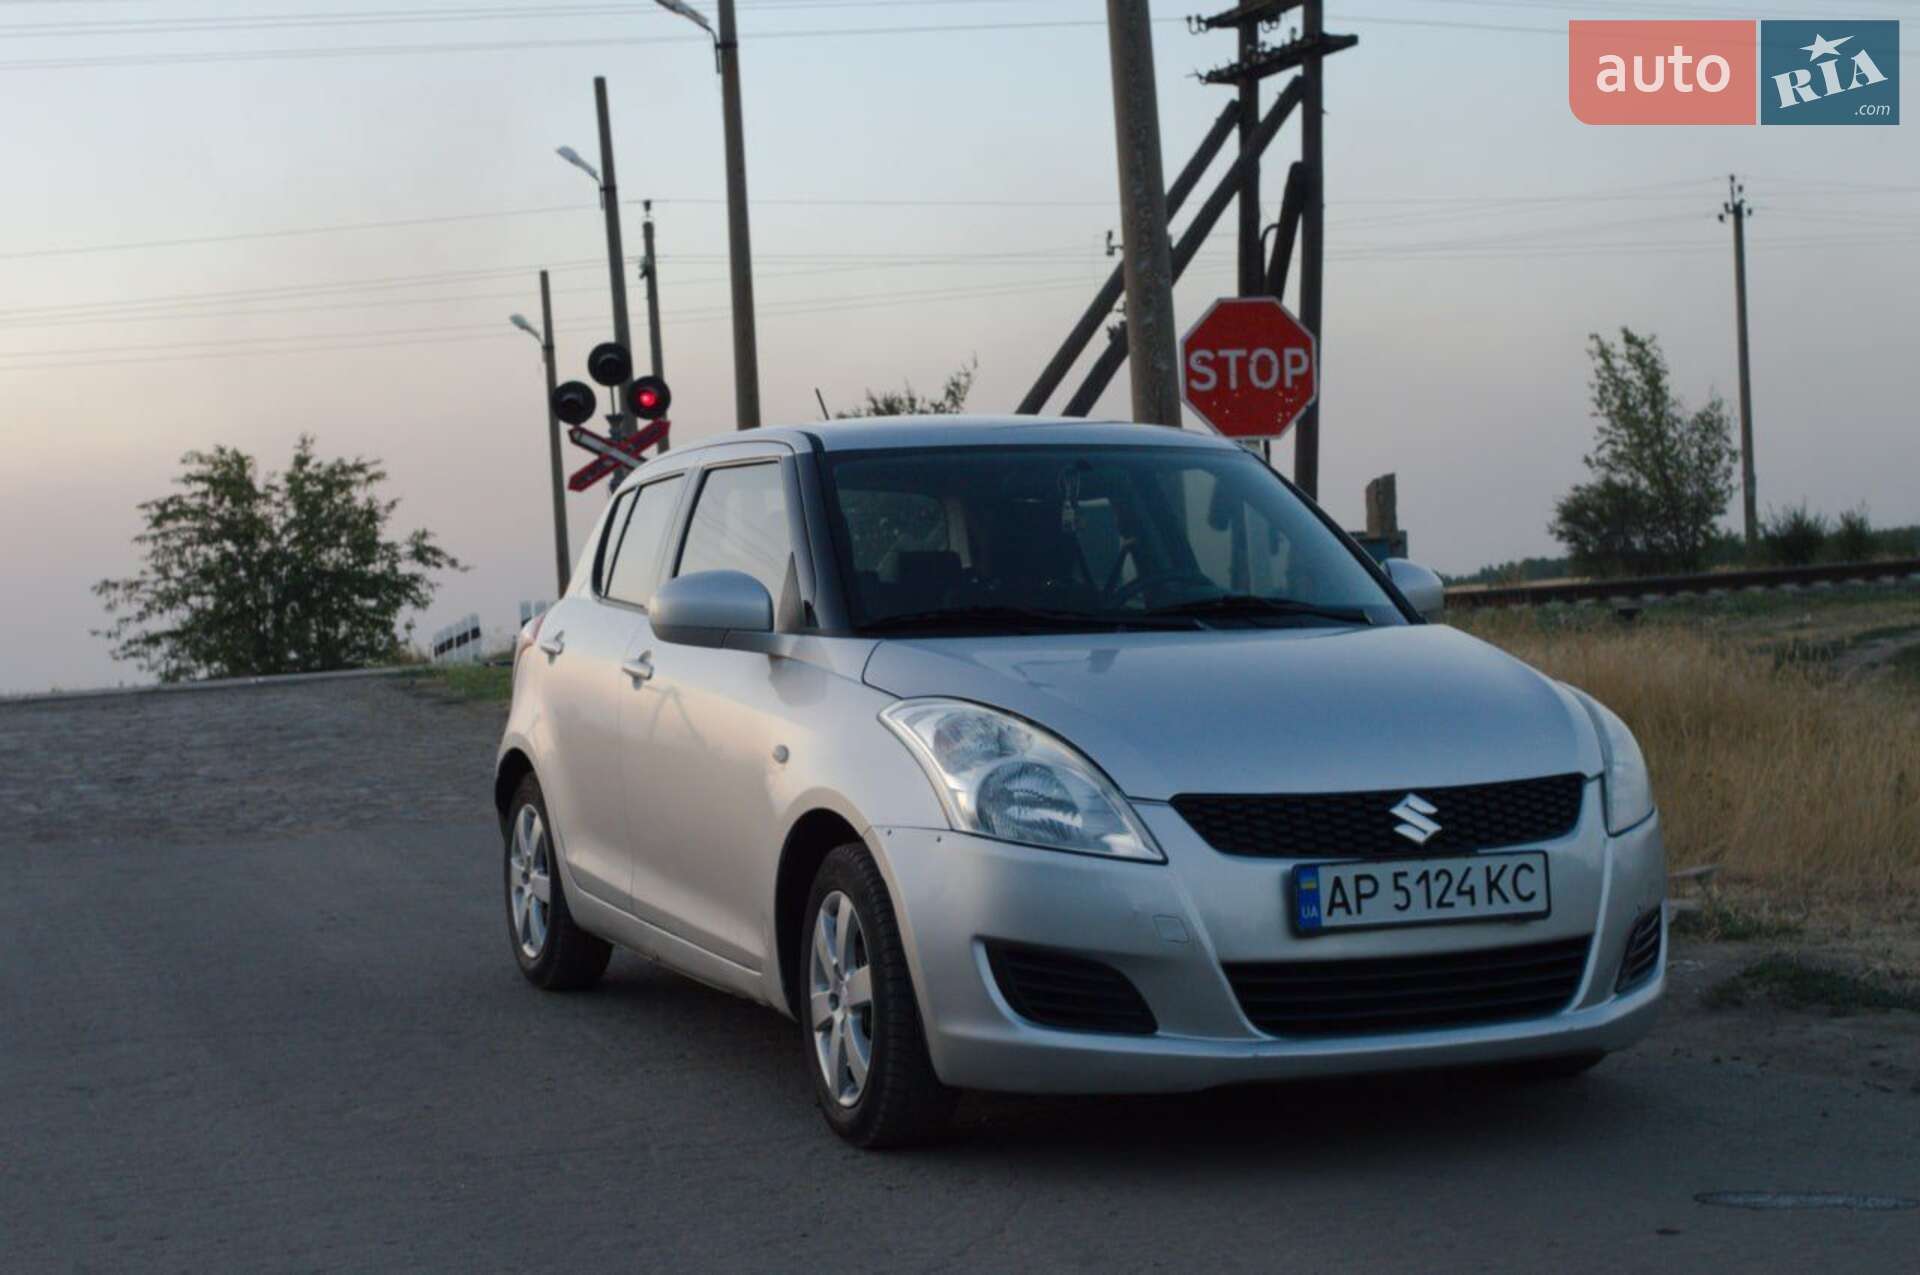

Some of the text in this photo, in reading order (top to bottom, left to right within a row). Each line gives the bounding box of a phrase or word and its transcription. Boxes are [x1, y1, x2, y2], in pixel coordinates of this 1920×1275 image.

[1189, 347, 1309, 391] STOP
[1327, 863, 1536, 917] AP 5124 KC
[1301, 906, 1319, 919] UA
